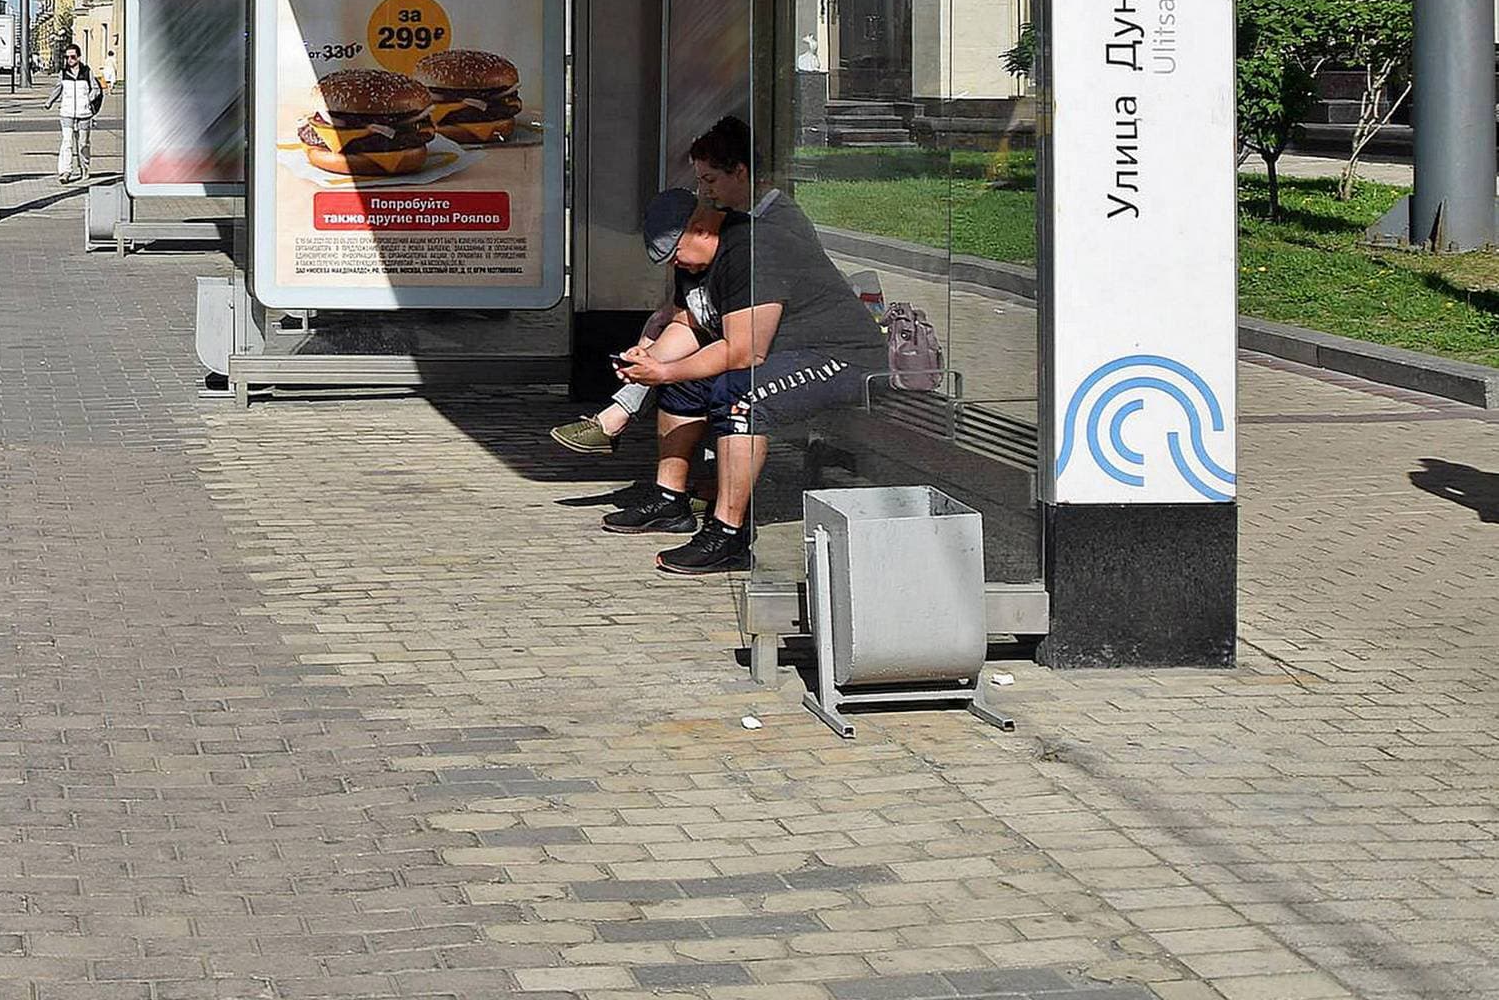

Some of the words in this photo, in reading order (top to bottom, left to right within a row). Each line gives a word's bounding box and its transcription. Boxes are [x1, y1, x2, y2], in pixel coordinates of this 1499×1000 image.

[398, 10, 421, 22] за
[1105, 95, 1143, 219] Улица
[371, 198, 450, 211] Попробуйте
[323, 214, 365, 223] также
[367, 213, 413, 226] другие
[415, 213, 450, 226] пары
[452, 212, 500, 223] Роялов
